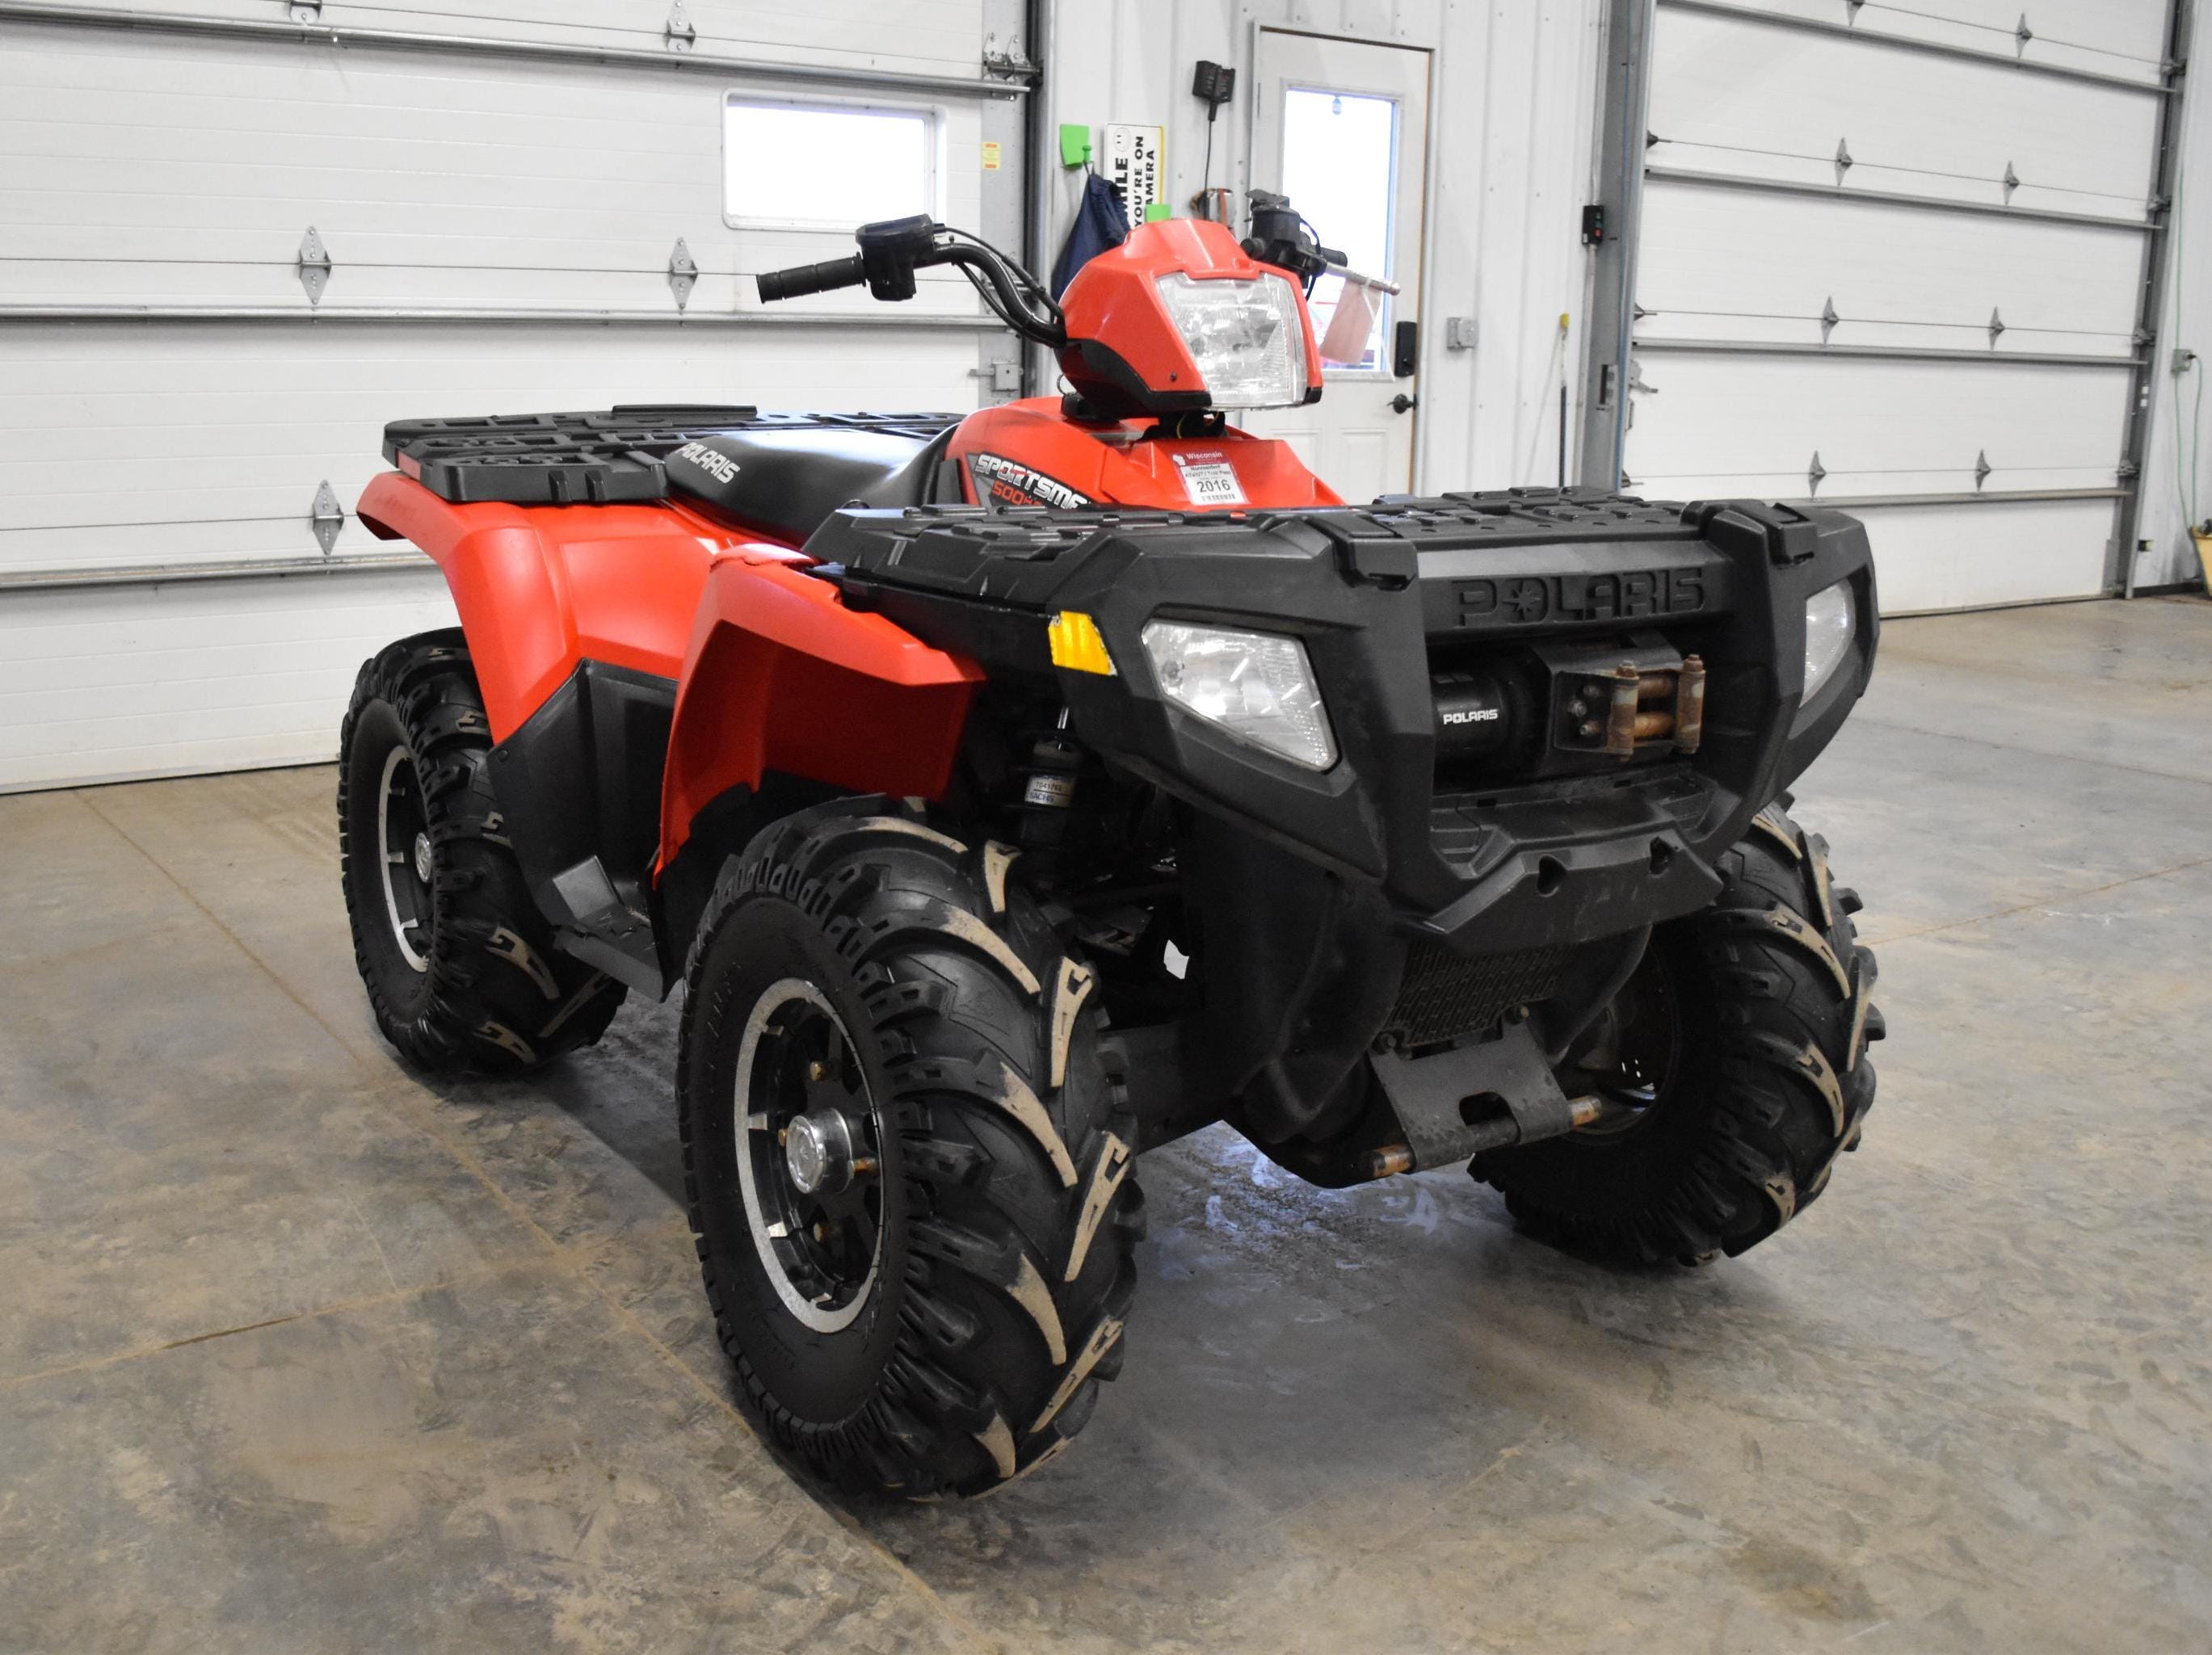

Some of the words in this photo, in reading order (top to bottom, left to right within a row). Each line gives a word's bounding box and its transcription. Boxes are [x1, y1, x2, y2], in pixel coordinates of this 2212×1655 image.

[1134, 136, 1144, 160] ON
[1146, 149, 1154, 204] AMERA
[1133, 168, 1143, 227] YOU'RE
[675, 442, 741, 484] POLARIS
[1186, 452, 1223, 460] Wisconsin
[1196, 479, 1231, 493] 2016
[1452, 567, 1705, 628] POLARIS
[1443, 709, 1499, 725] POLARIS
